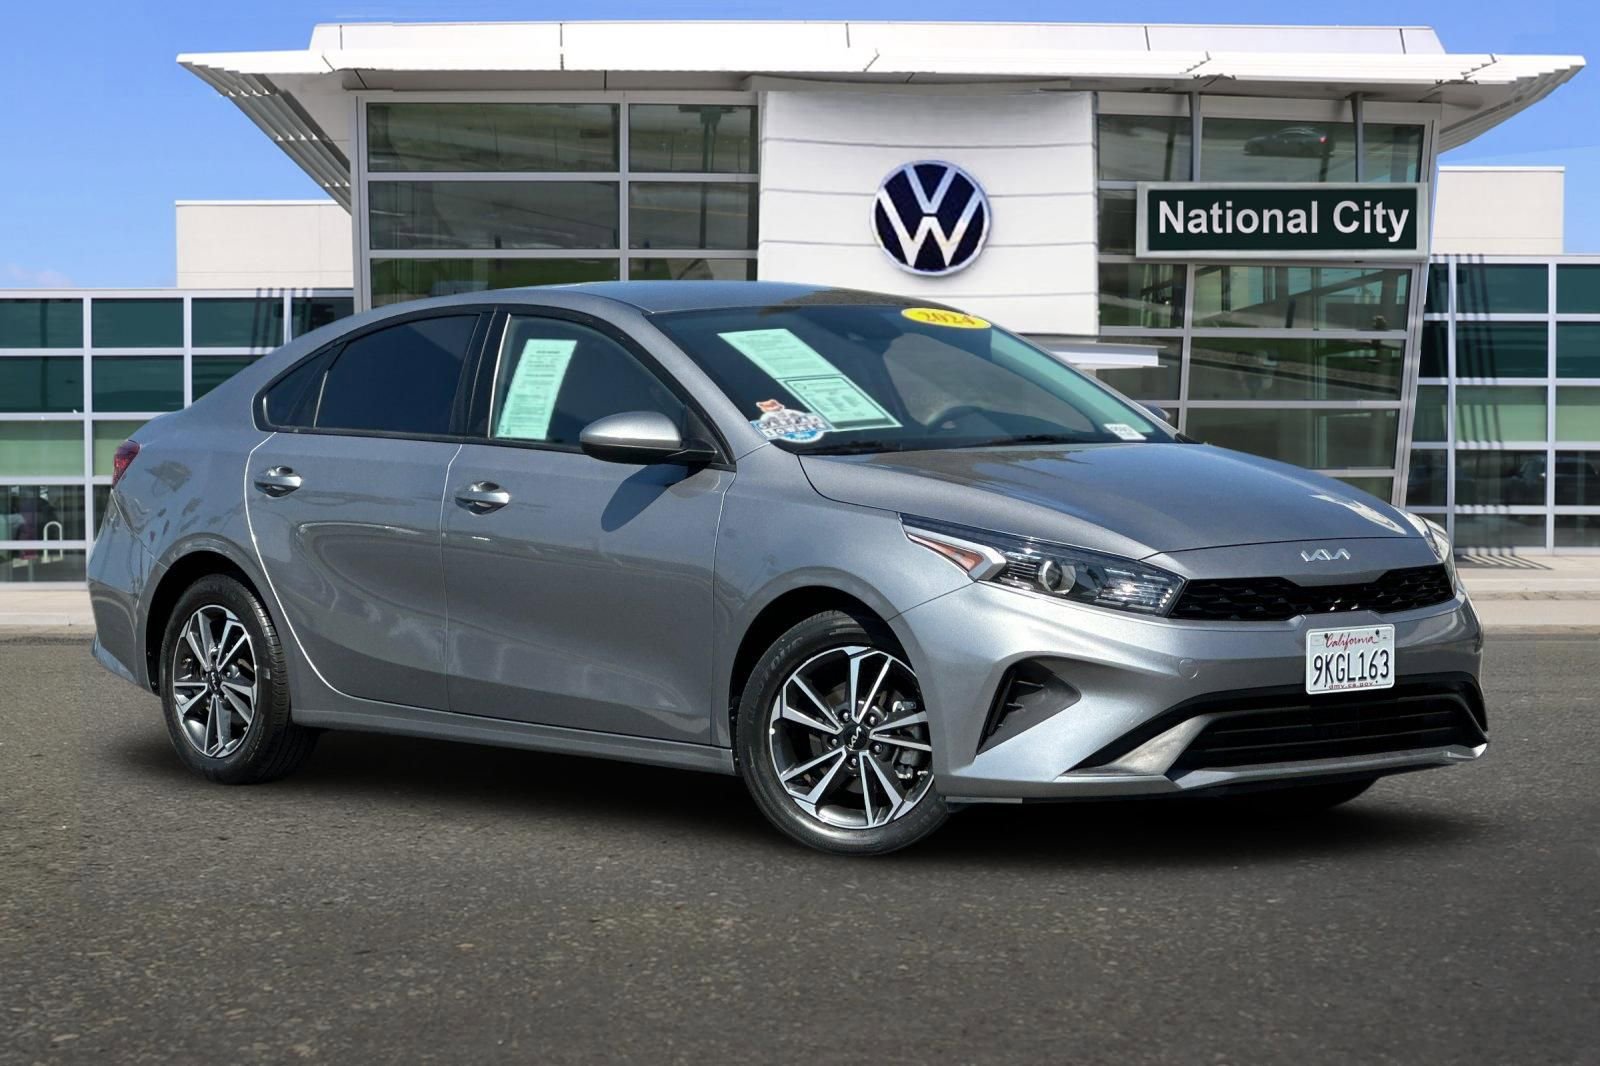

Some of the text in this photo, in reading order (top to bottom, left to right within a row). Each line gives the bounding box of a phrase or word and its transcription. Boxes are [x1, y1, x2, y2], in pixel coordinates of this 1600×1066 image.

[873, 163, 987, 272] VW
[1159, 200, 1410, 242] National City
[916, 311, 976, 325] 2024
[1300, 548, 1351, 562] KIA
[1325, 632, 1380, 651] California
[1313, 649, 1389, 685] 9KGL163
